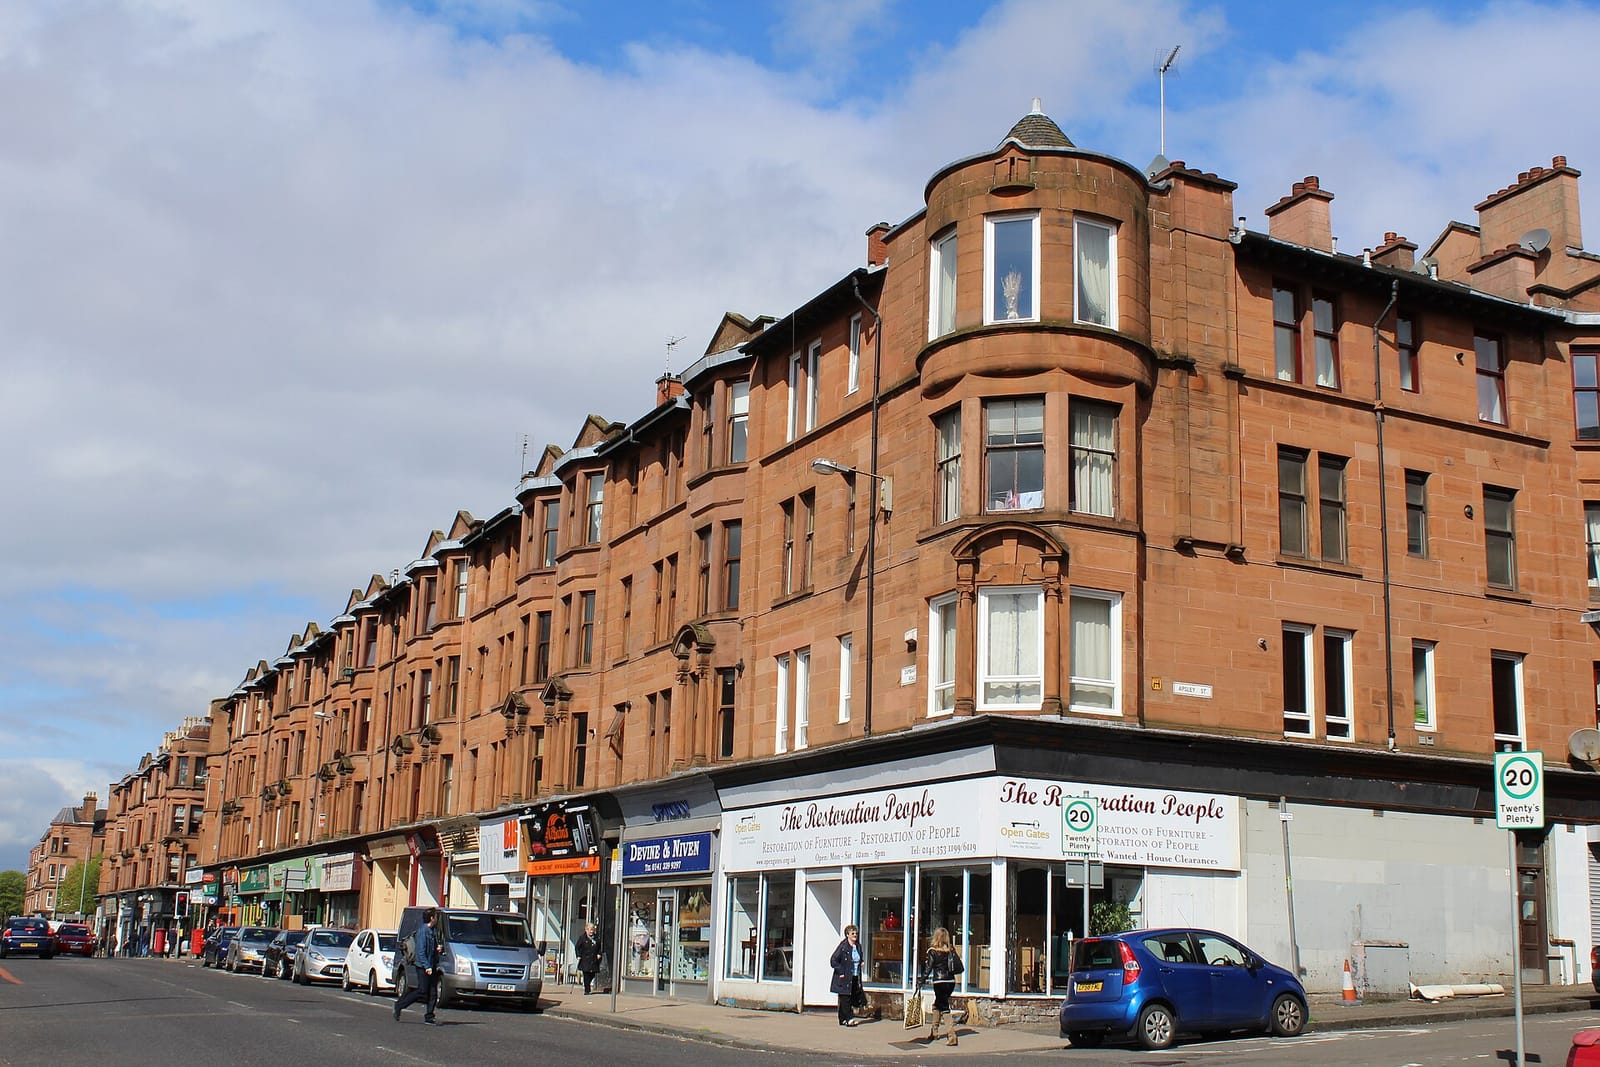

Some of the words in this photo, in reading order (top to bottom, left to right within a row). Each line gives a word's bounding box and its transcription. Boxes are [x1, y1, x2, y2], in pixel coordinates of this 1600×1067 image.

[1506, 769, 1532, 786] 20
[1000, 781, 1038, 805] The
[1161, 794, 1224, 824] People
[1500, 804, 1540, 814] Twenty's
[780, 806, 802, 832] The
[804, 801, 881, 830] Restoration
[883, 788, 935, 828] People
[1069, 810, 1090, 822] 20
[1506, 814, 1534, 824] Plenty
[504, 818, 518, 850] BIG
[735, 823, 747, 834] Open
[748, 822, 760, 832] Gates
[1000, 827, 1024, 839] Open
[1026, 829, 1050, 840] Gates
[1141, 827, 1154, 836] OF
[1156, 826, 1207, 840] FURNITURE
[762, 840, 802, 854] RESTORATION
[804, 840, 814, 850] OF
[814, 836, 852, 850] FURNITURE
[860, 831, 914, 845] RESTORATION
[916, 830, 926, 840] OF
[928, 826, 960, 840] PEOPLE
[1065, 834, 1095, 842] Twenty's
[1151, 840, 1163, 849] OF
[1166, 839, 1200, 850] PEOPLE
[630, 844, 660, 862] DEVINE
[662, 840, 670, 858] &
[672, 840, 700, 858] NIVEN
[922, 846, 935, 856] 0141
[936, 845, 947, 855] 353
[1069, 842, 1090, 850] Plenty
[1107, 850, 1137, 860] Wanted
[1146, 853, 1172, 863] House
[1175, 854, 1218, 865] Clearances
